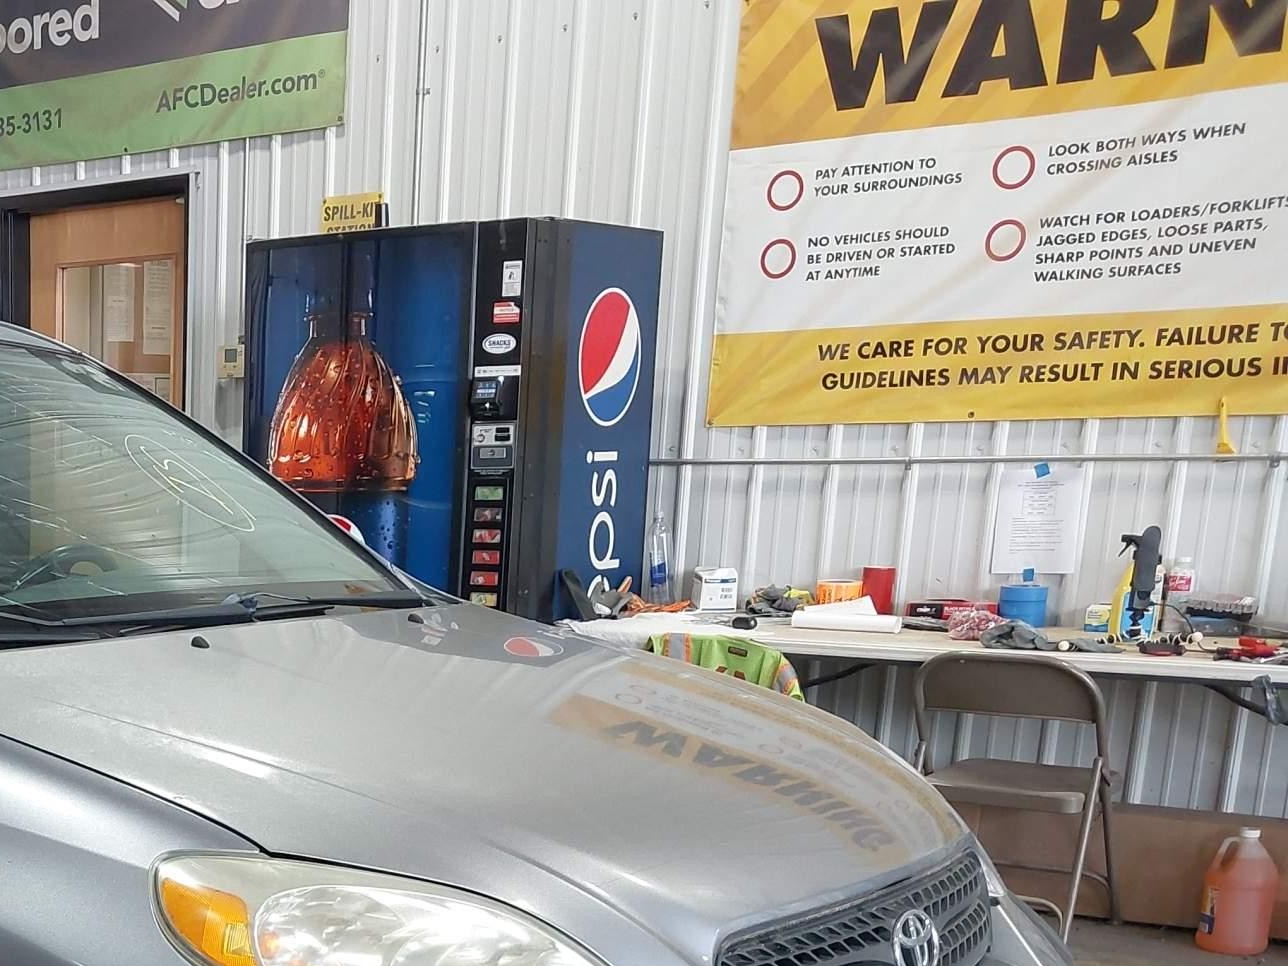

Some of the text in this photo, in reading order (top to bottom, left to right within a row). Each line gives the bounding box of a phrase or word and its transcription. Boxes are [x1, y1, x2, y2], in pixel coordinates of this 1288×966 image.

[1049, 123, 1246, 157] LOOK BOTH WAYS WHEN
[815, 158, 936, 180] PAY ATTENTION TO
[1047, 150, 1178, 175] CROSSING AISLES
[814, 173, 962, 197] YOUR SURROUNDINGS
[1039, 213, 1090, 228] WATCH
[1096, 211, 1126, 225] FOR
[808, 226, 949, 248] NO VEHICLES SHOULD
[1036, 218, 1268, 246] JAGGED EDGES, LOOSE PARTS,
[807, 244, 955, 265] BE DRIVEN OR STARTED
[1035, 238, 1256, 264] SHARP POINTS AND UNEVEN
[806, 266, 880, 281] AT ANYTIME
[1034, 262, 1181, 282] WALKING SURFACES
[818, 322, 1288, 361] WE CARE FOR YOUR SAFETY. FAILURE T
[822, 368, 950, 390] GUIDELINES
[958, 366, 1013, 385] MAY
[1019, 363, 1103, 383] RESULT
[1111, 361, 1140, 380] IN
[1149, 357, 1262, 379] SERIOUS
